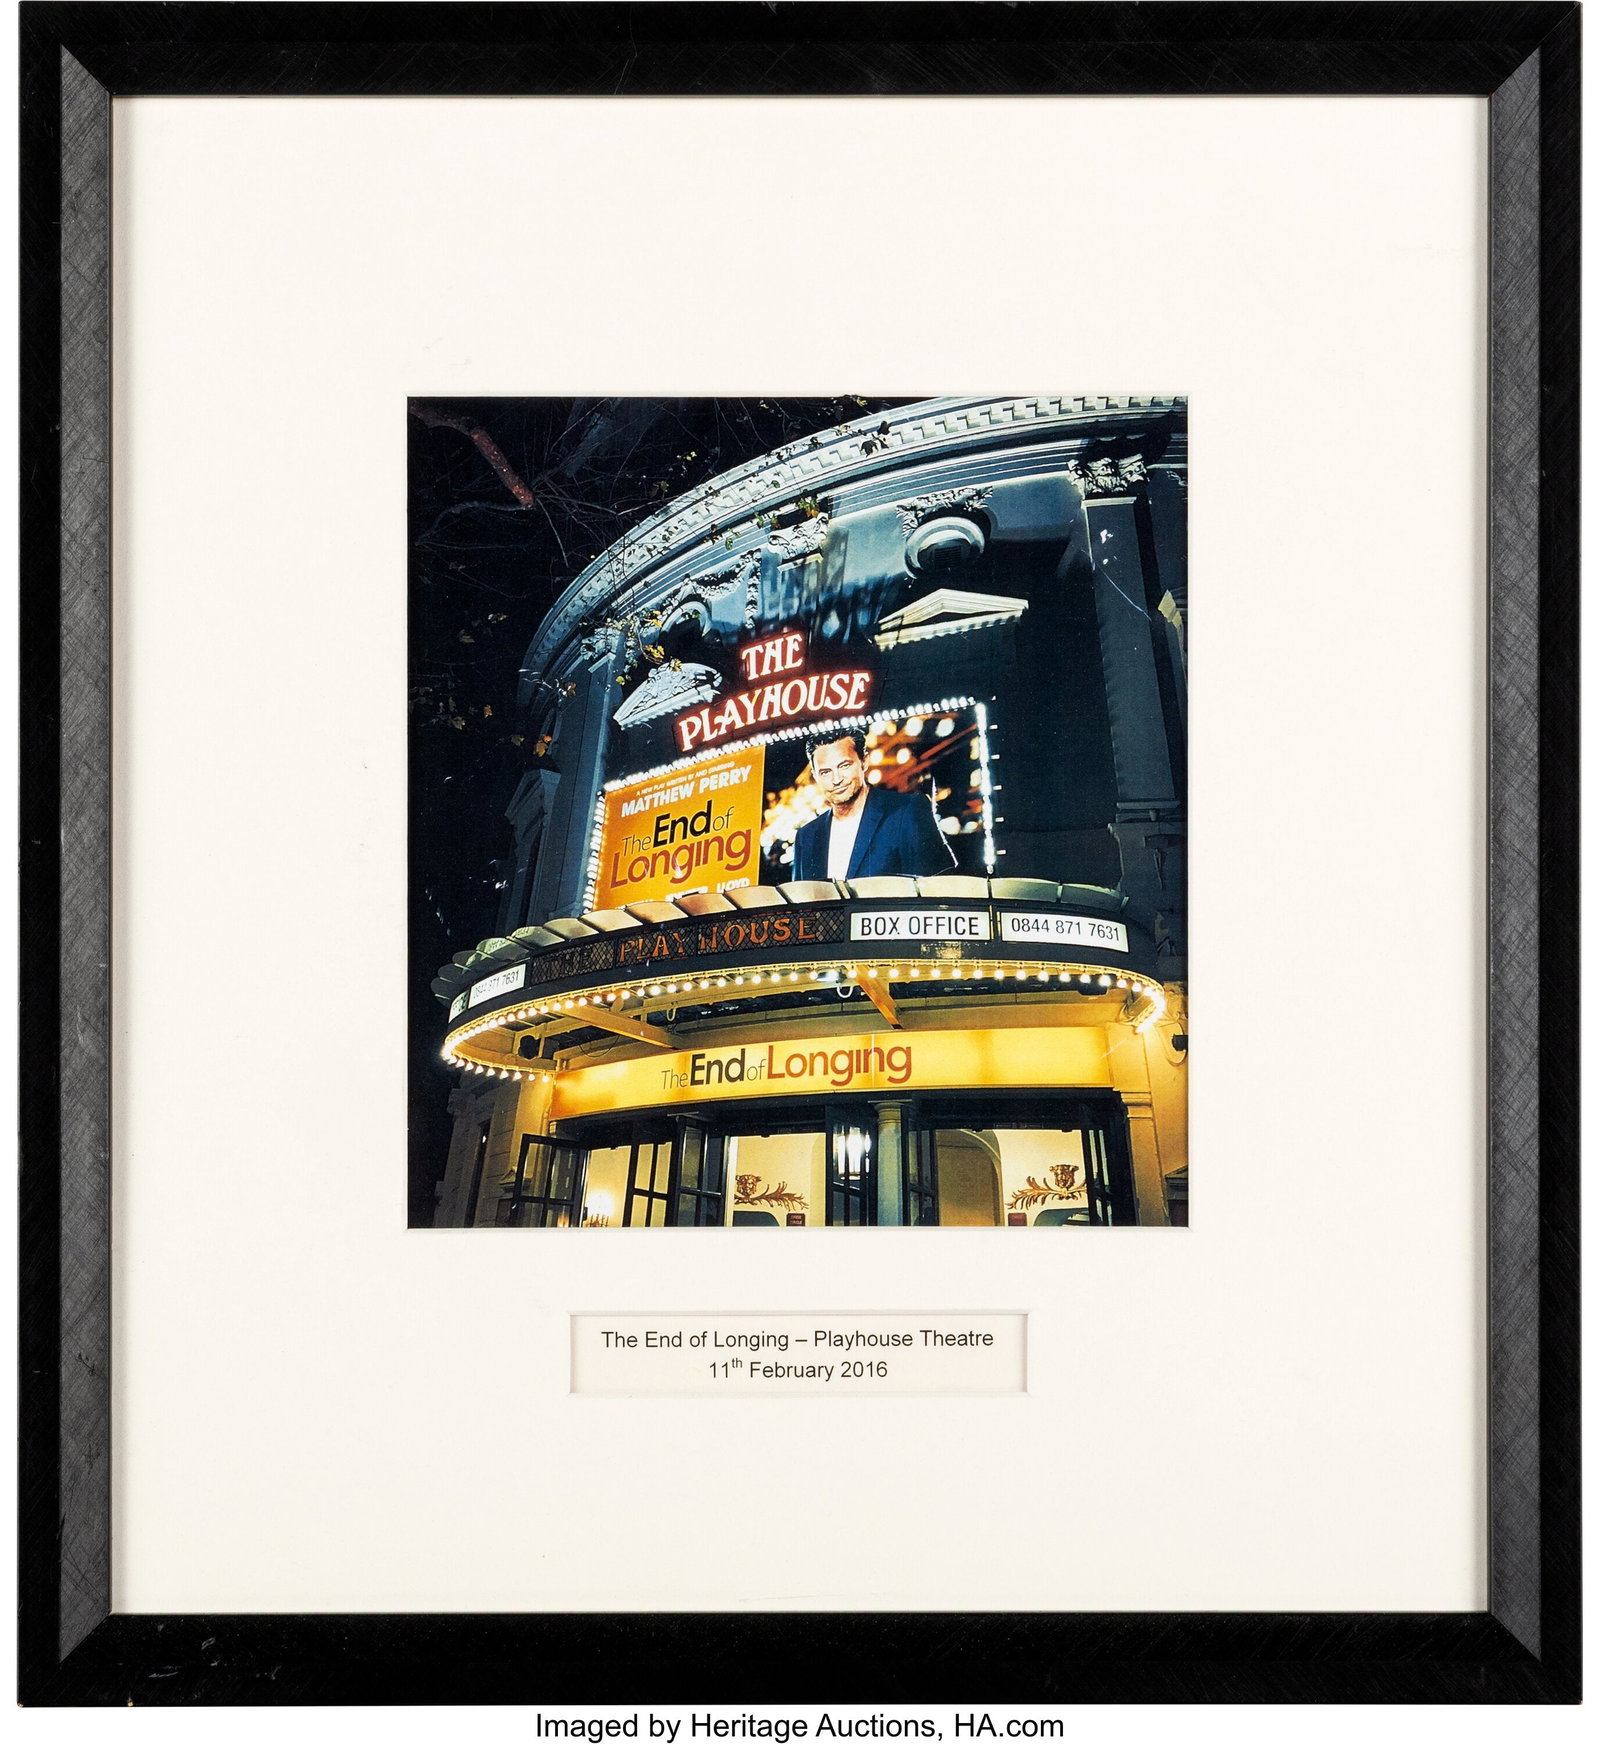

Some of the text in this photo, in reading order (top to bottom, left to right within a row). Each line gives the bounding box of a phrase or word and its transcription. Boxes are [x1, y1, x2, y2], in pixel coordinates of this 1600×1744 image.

[741, 633, 804, 681] THE
[678, 672, 871, 752] PLAYHOUSE
[621, 765, 752, 818] MATTHEW PERRY
[622, 799, 735, 856] The End of
[610, 829, 752, 889] Longing
[860, 916, 980, 937] BOX OFFICE
[1011, 917, 1121, 942] 0844 871 7631
[502, 970, 520, 985] 7631
[661, 1045, 912, 1090] The End of Longing
[601, 1331, 638, 1348] The
[645, 1331, 682, 1348] End
[690, 1330, 708, 1348] of
[714, 1331, 789, 1352] Longing
[814, 1330, 913, 1351] Playhouse
[919, 1330, 994, 1347] Theatre
[709, 1357, 888, 1382] 11th February 2016
